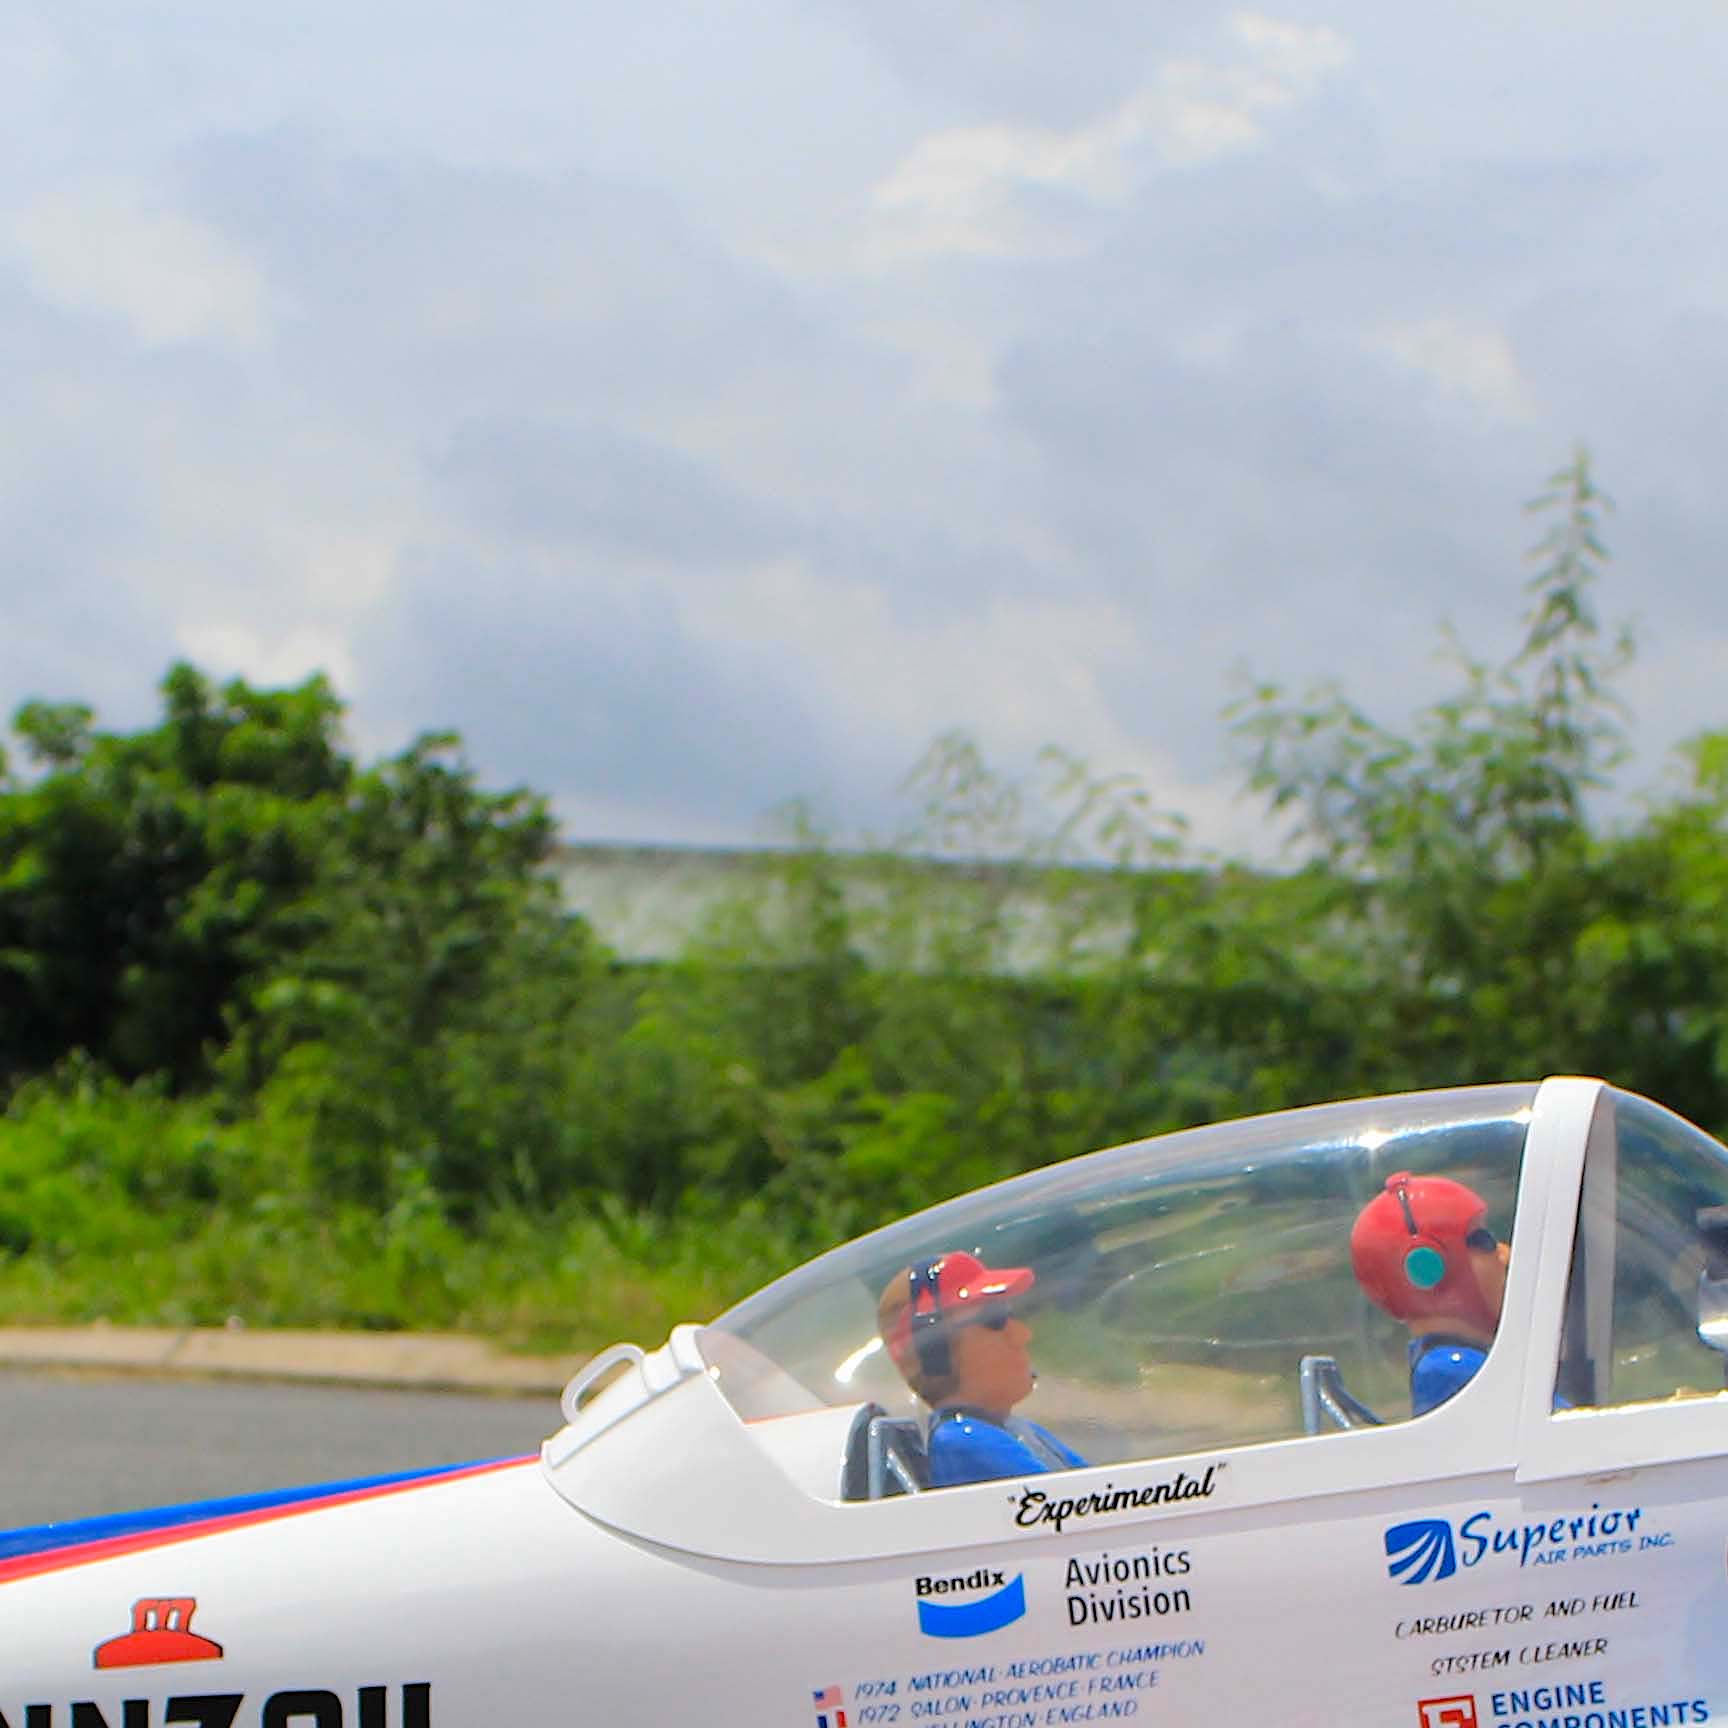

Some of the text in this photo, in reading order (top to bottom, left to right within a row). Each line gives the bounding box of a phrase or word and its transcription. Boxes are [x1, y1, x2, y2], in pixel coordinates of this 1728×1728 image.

[1460, 1503, 1643, 1568] Superior
[1534, 1549, 1567, 1568] AIR
[1573, 1539, 1632, 1561] PARTS
[915, 1569, 1005, 1596] Bendix
[1065, 1547, 1191, 1589] Avionics
[1067, 1585, 1191, 1627] Division
[1395, 1590, 1640, 1639] CARBURETOR AND FUEL
[855, 1680, 896, 1700] 1974
[1106, 1639, 1205, 1667] CHAMPION
[1520, 1637, 1608, 1665] CLEANER
[859, 1704, 901, 1725] 1972
[1088, 1670, 1160, 1695] FRANCE
[1491, 1681, 1606, 1716] ENGINE
